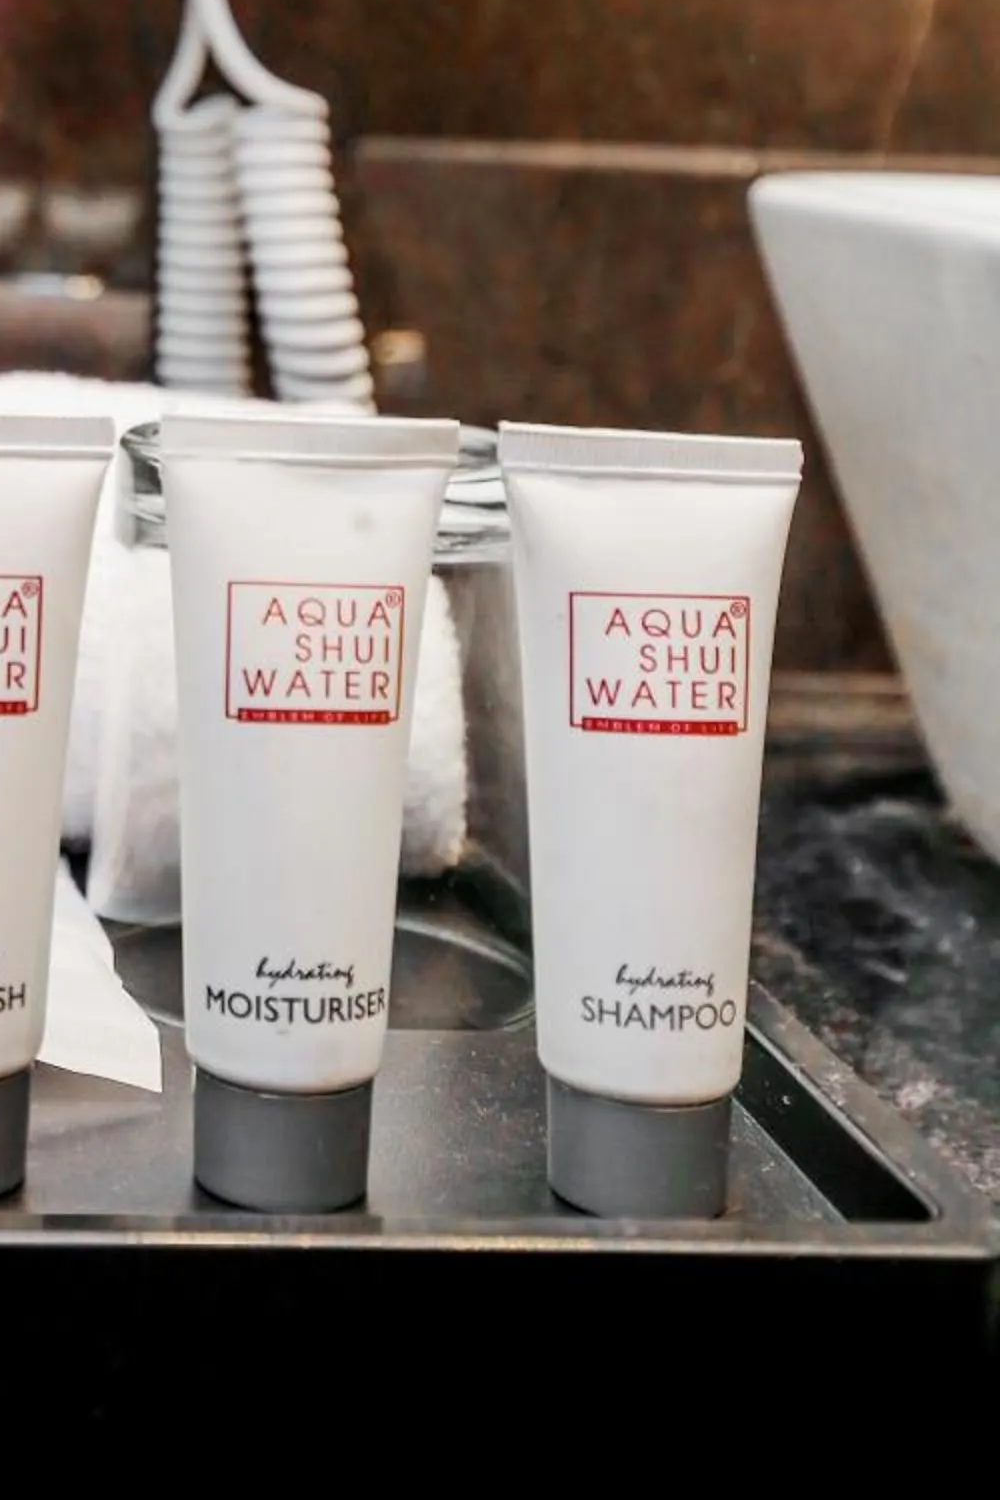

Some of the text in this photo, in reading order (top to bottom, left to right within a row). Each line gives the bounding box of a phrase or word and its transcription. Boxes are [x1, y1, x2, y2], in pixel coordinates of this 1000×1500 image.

[294, 633, 390, 664] SHUI
[638, 643, 736, 674] SHUI
[242, 668, 391, 700] WATER
[585, 677, 737, 710] WATER
[255, 956, 355, 989] hydrating
[615, 963, 716, 997] hydrating
[205, 984, 386, 1025] MOISTURISER
[580, 995, 737, 1031] SHAMPOO
